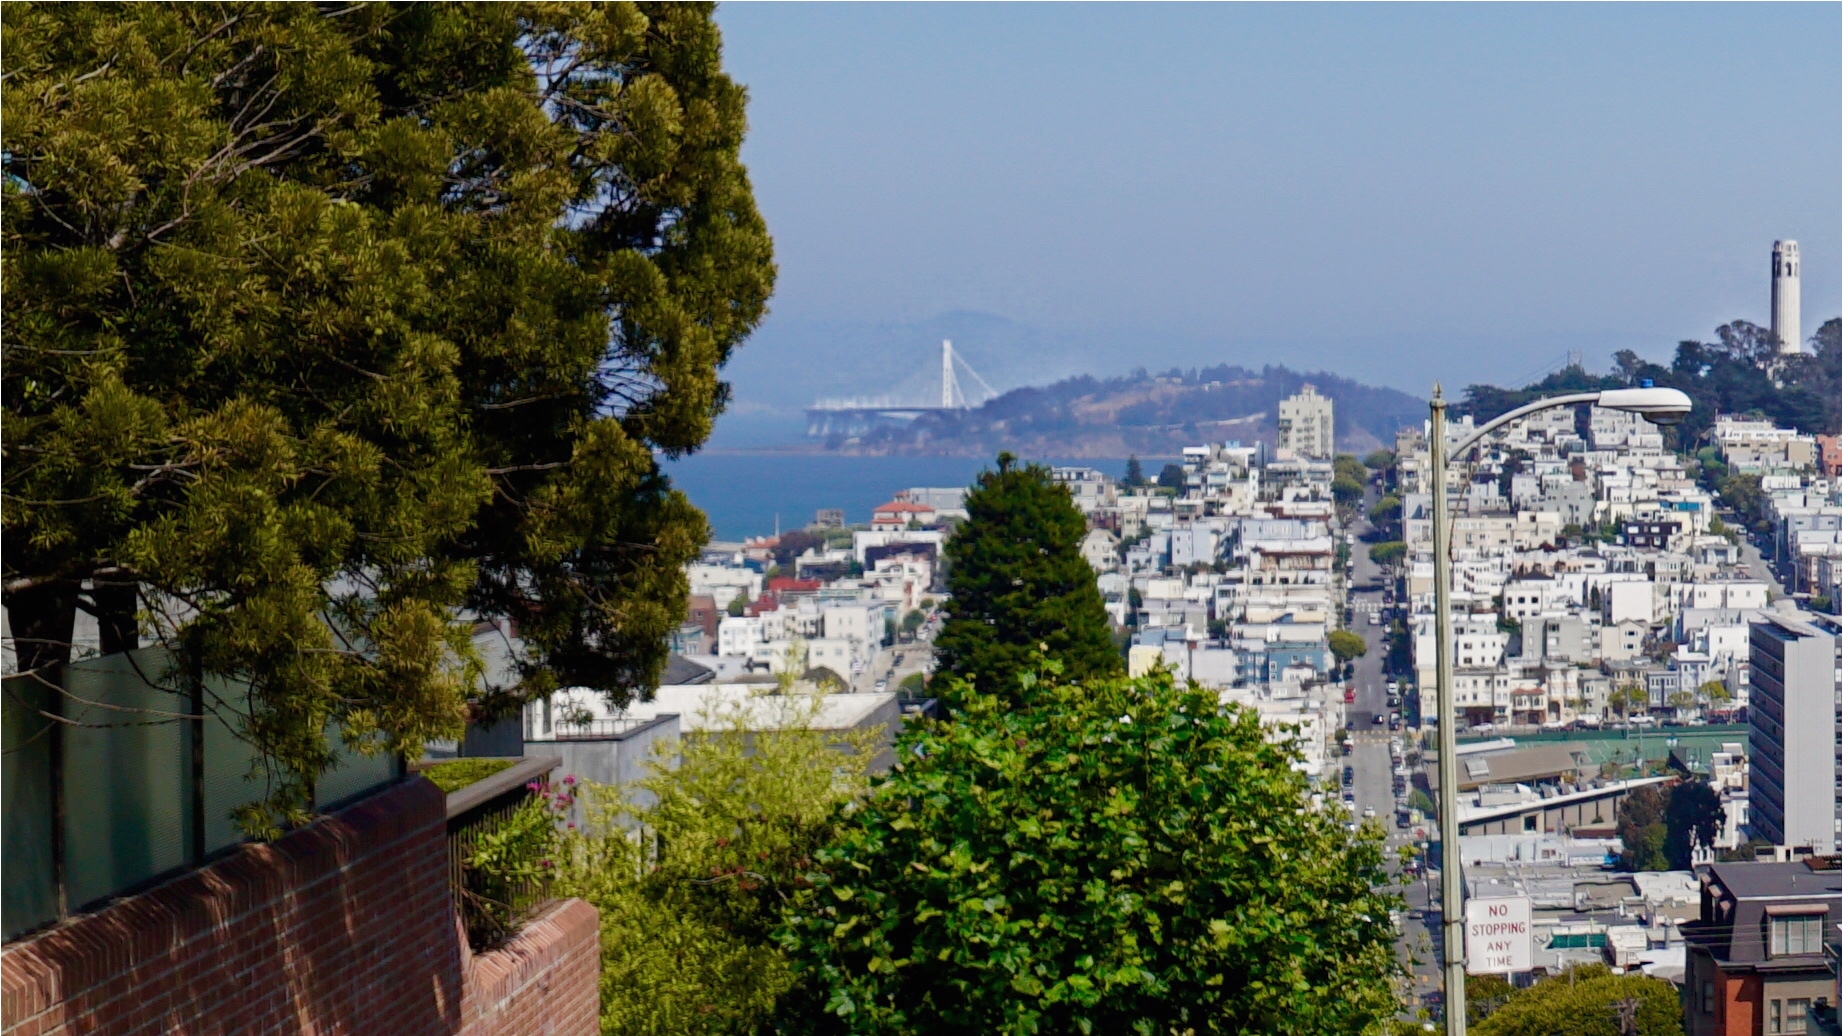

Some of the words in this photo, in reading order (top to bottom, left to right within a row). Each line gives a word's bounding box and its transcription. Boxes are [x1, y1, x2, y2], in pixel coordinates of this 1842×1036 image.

[1489, 904, 1508, 917] NO
[1472, 922, 1526, 937] STOPPING
[1487, 941, 1512, 952] ANY
[1486, 956, 1513, 967] TIME
